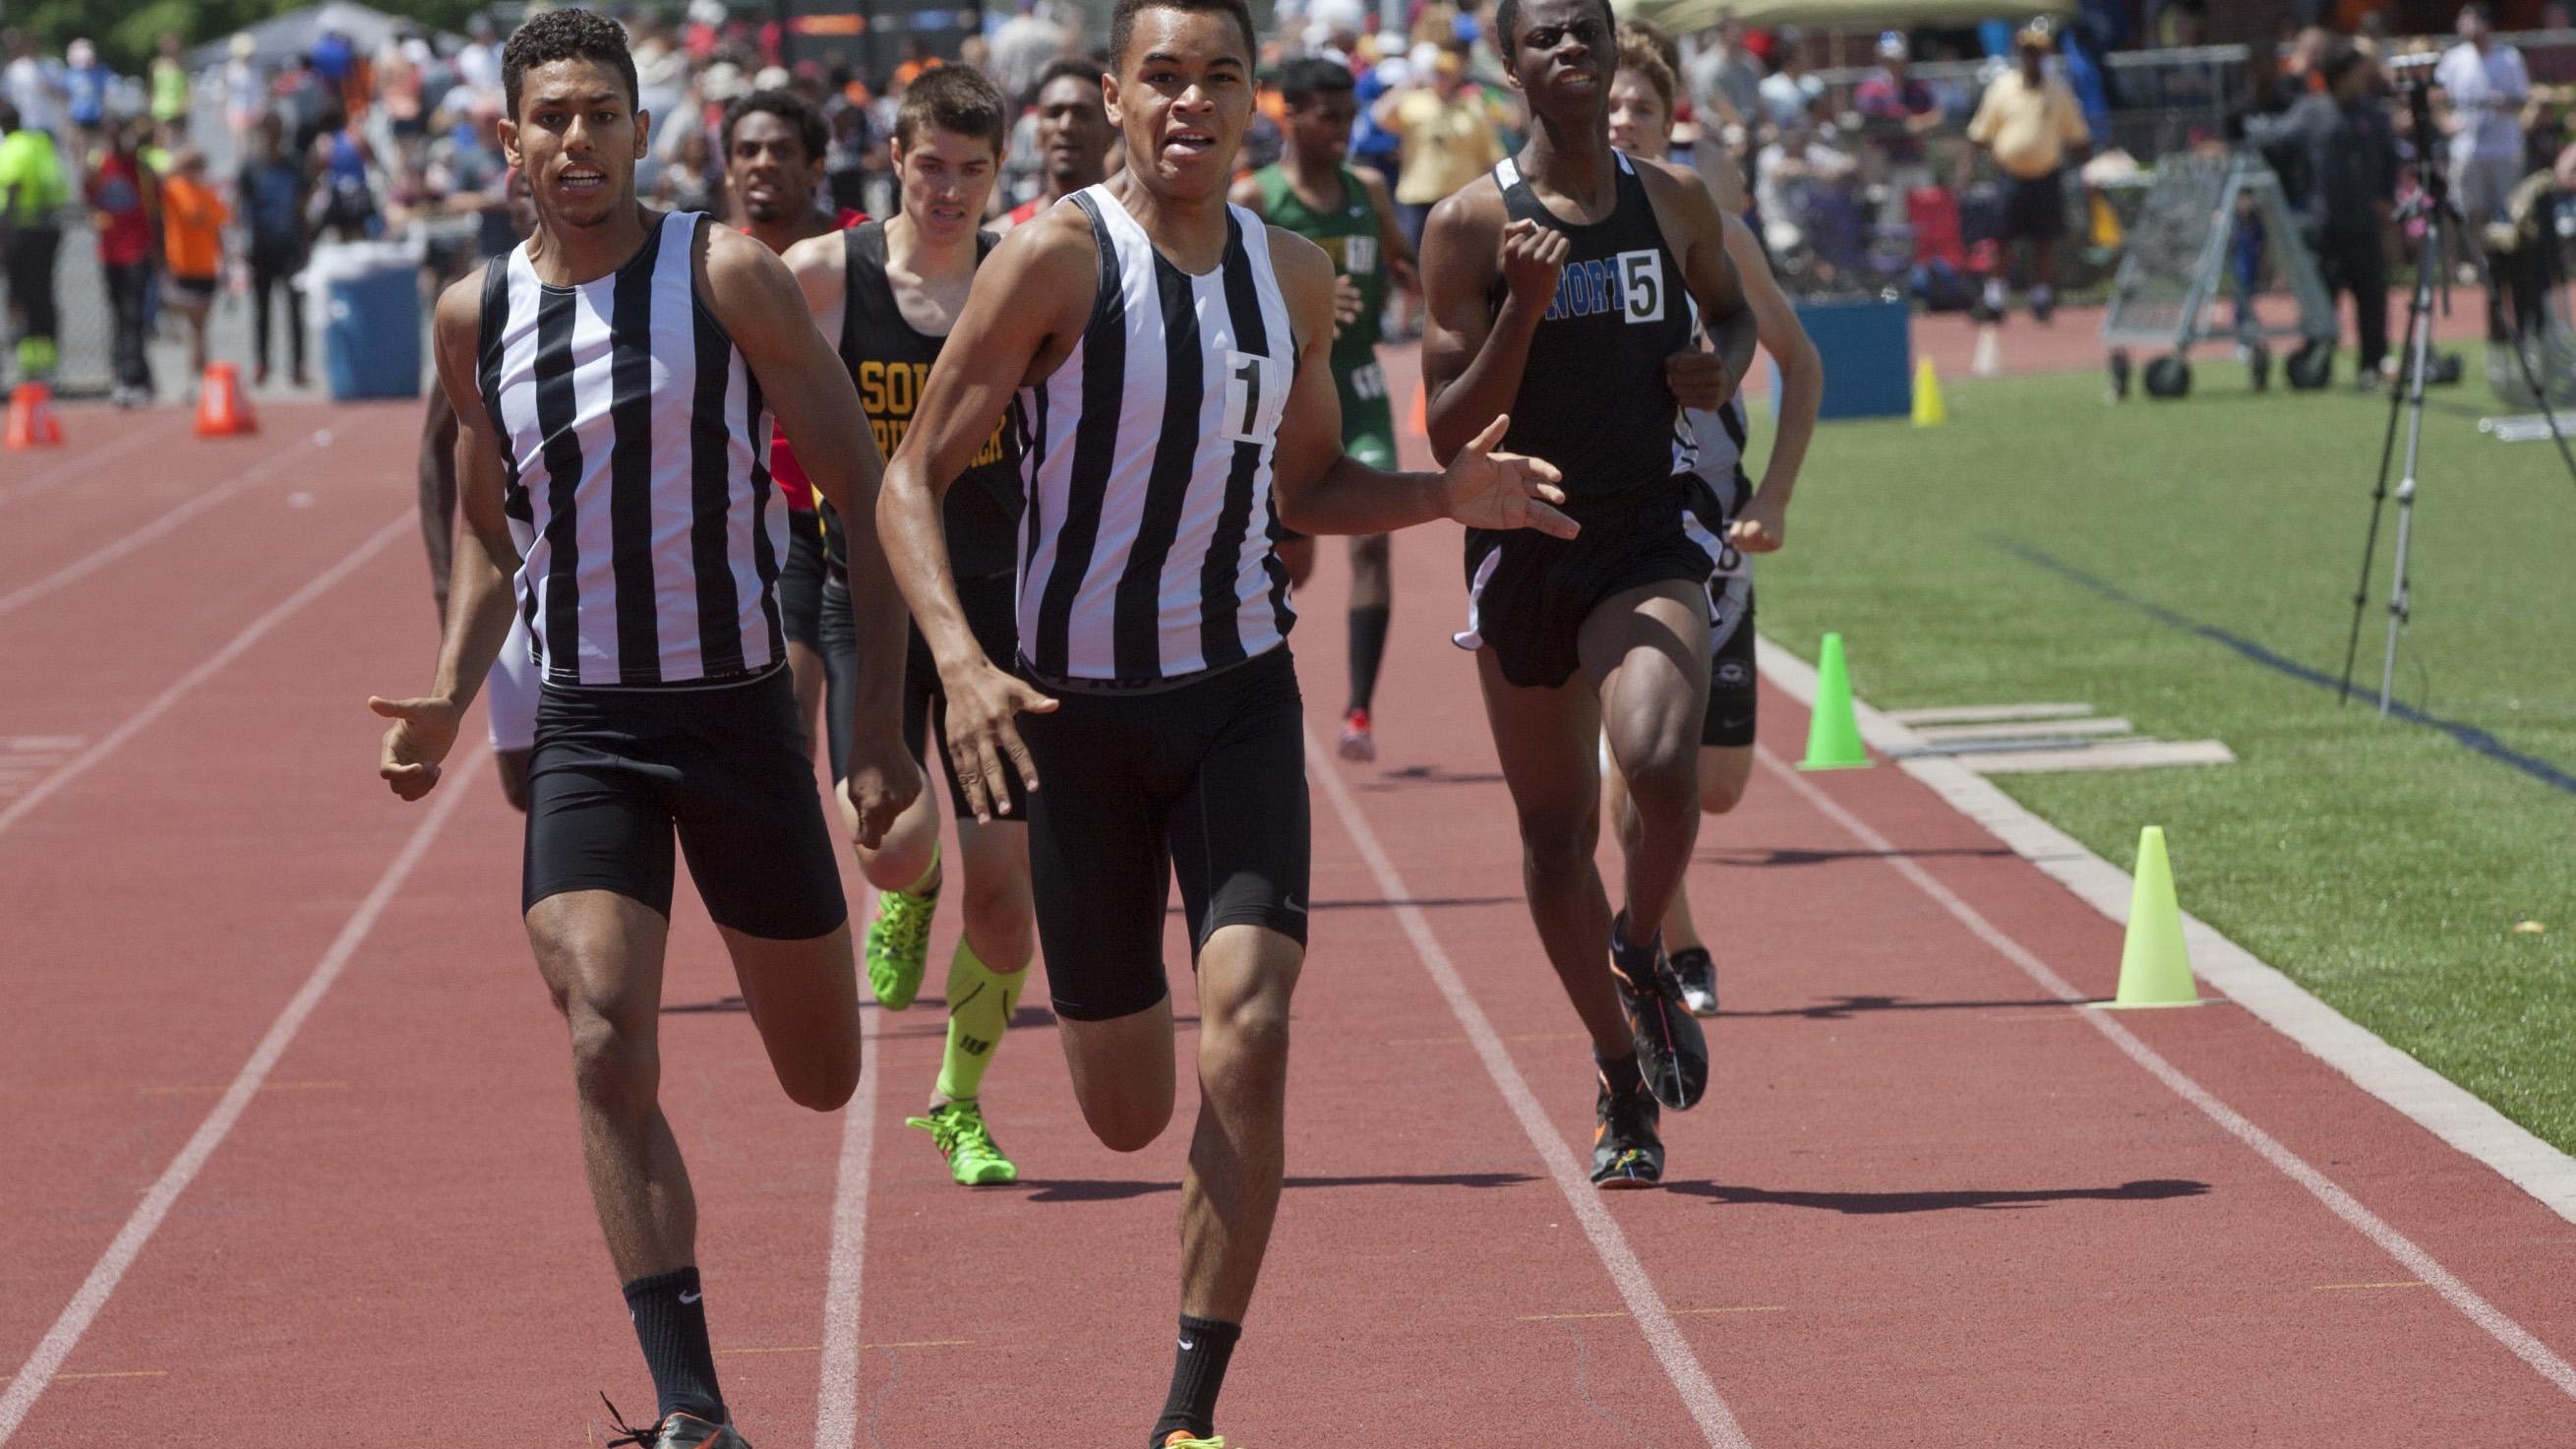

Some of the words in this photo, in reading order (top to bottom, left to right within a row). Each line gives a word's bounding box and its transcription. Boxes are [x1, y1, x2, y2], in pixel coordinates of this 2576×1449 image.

[1545, 257, 1625, 320] NORT
[1625, 256, 1657, 318] 5
[1234, 358, 1261, 436] 1
